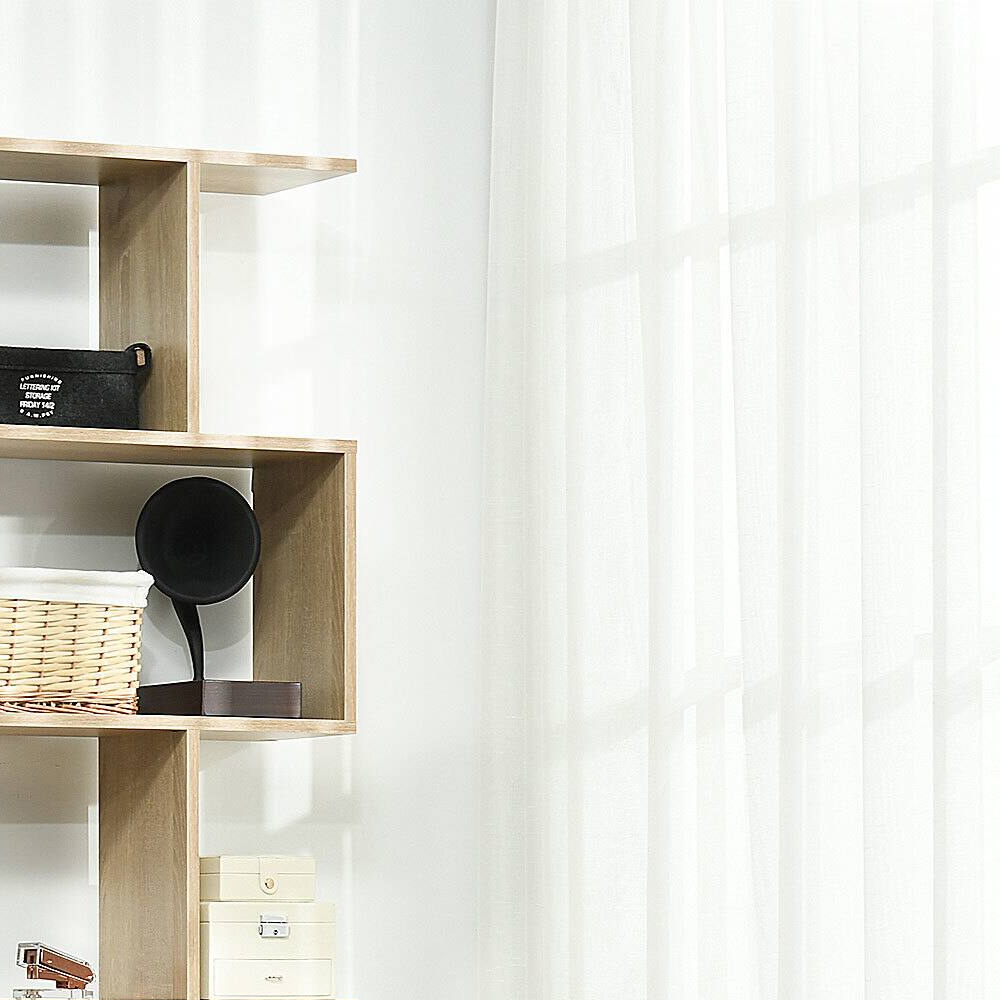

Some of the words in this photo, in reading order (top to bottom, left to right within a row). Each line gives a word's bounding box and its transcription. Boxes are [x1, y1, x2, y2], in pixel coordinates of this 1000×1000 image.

[20, 383, 50, 391] LETTERING
[24, 391, 52, 400] STORAGE
[20, 400, 41, 409] FRIDAY
